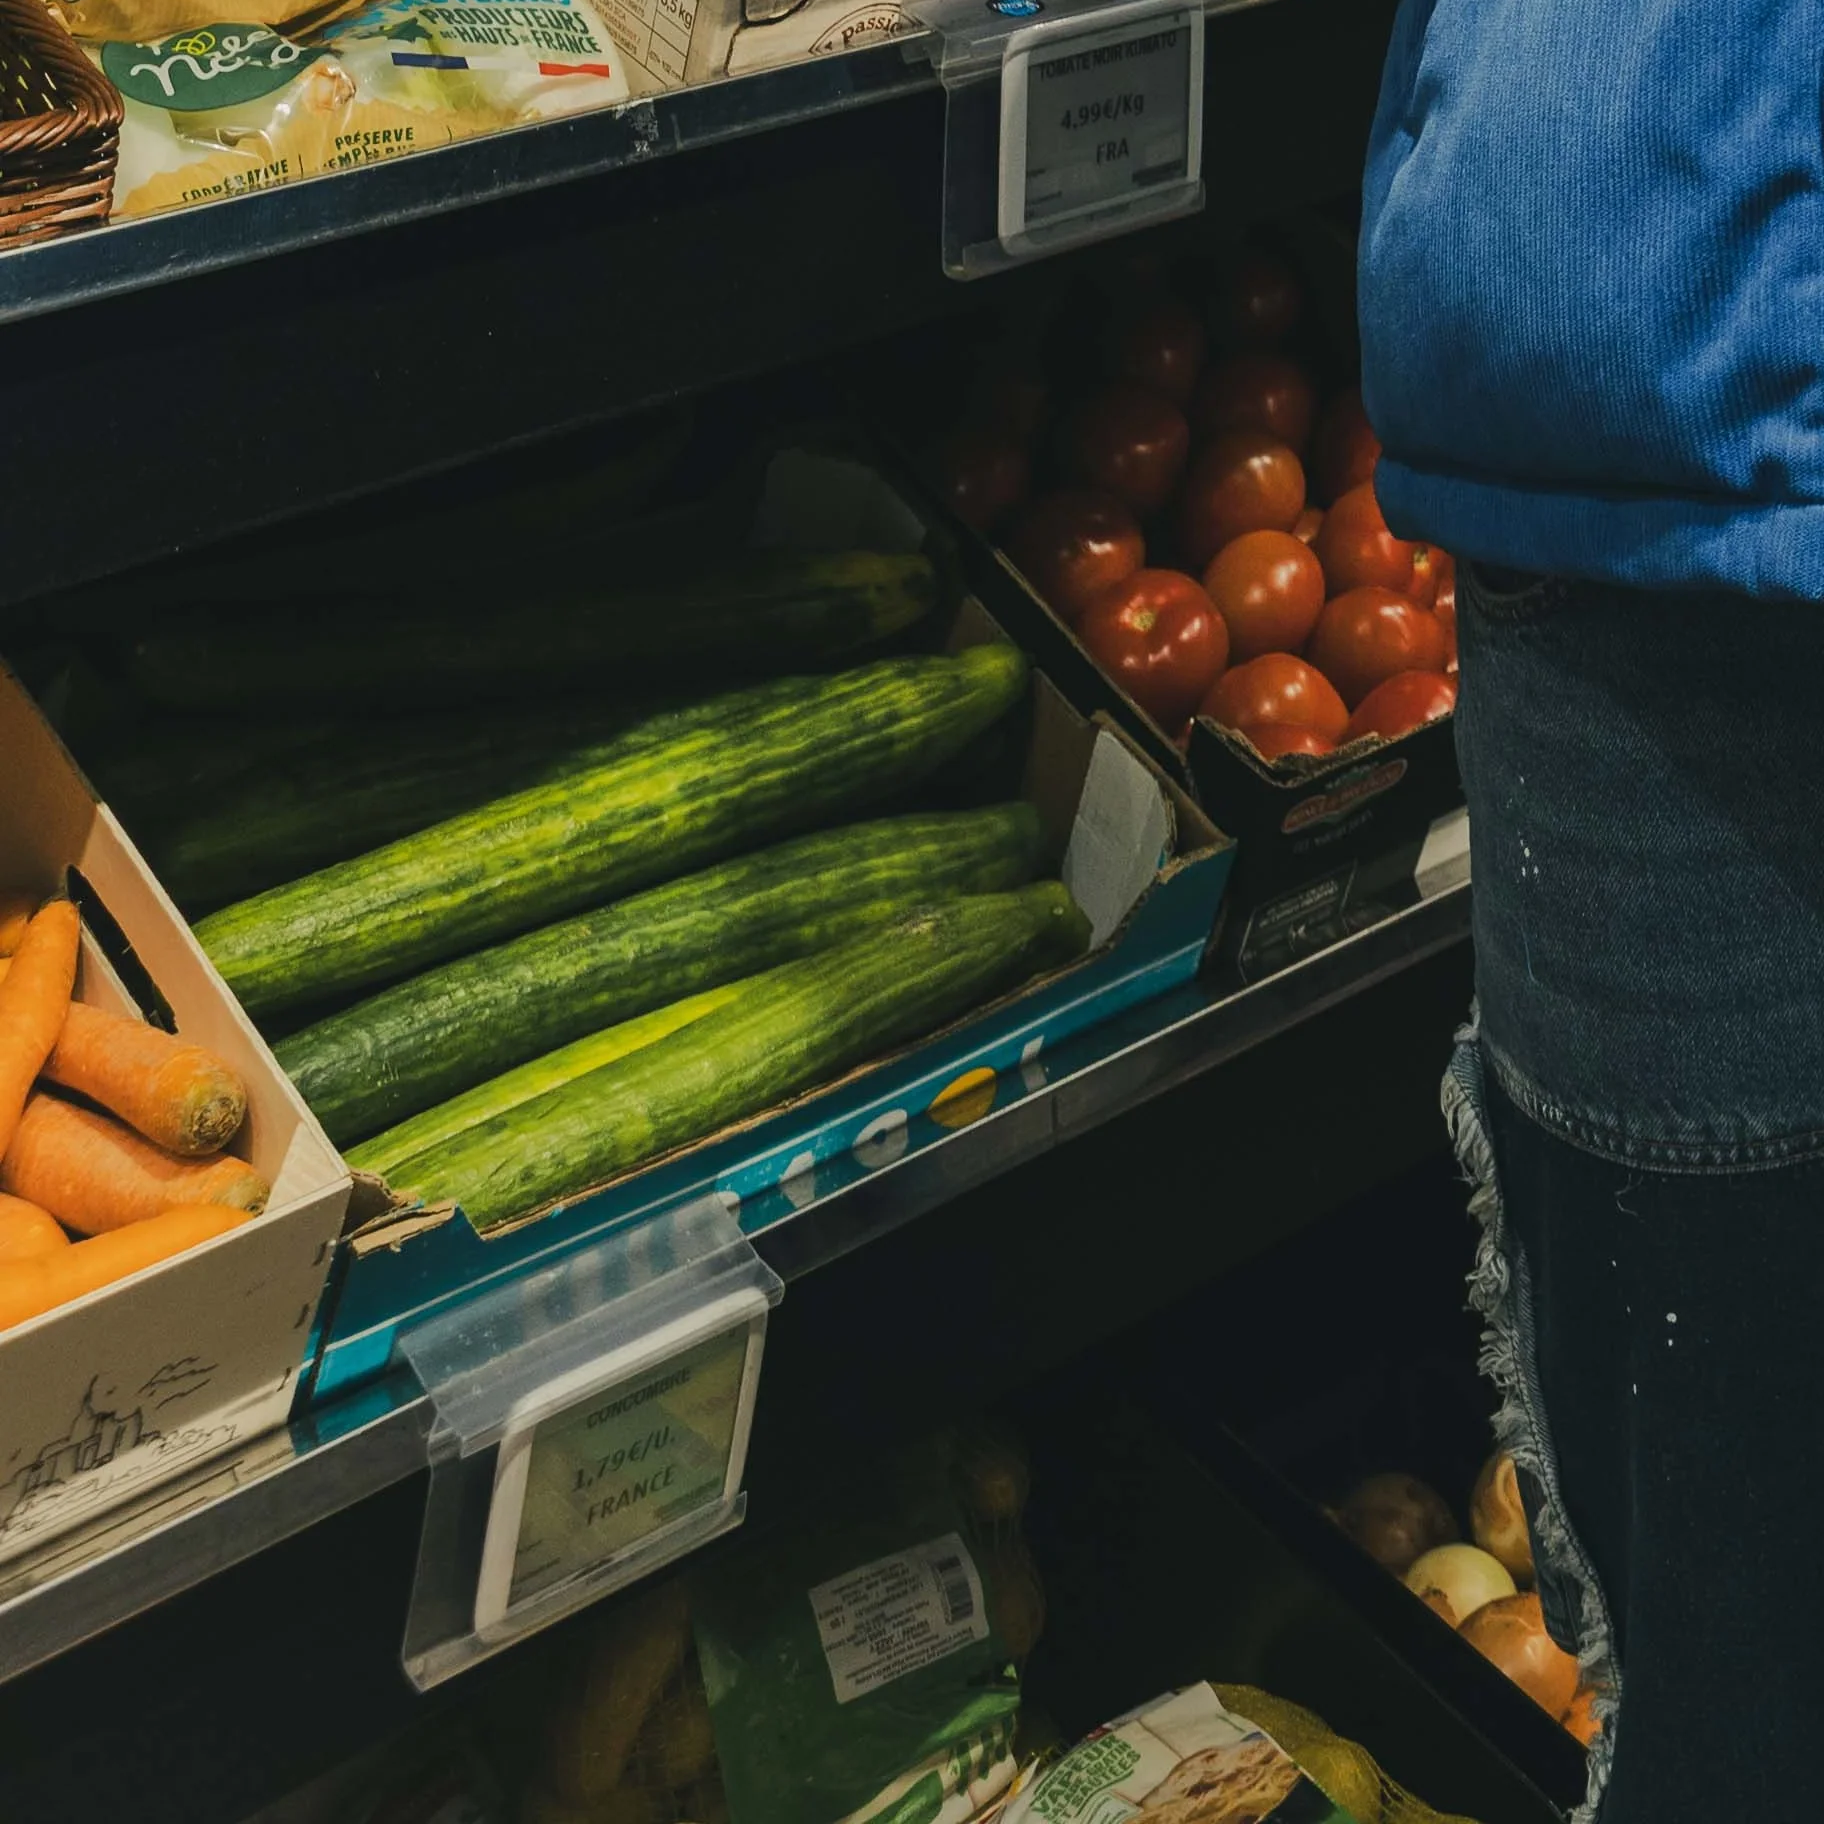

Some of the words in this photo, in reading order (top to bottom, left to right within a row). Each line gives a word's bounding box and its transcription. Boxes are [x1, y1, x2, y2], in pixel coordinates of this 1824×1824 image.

[418, 7, 590, 35] PRODUCTEURS
[678, 3, 693, 30] kg
[458, 26, 520, 47] HAUTS
[531, 31, 603, 54] FRANCE
[1039, 52, 1090, 81] TOMATE
[335, 127, 414, 151] PRÉSERVE
[1095, 141, 1130, 166] FRA
[586, 1367, 692, 1429] CONCOMBRE
[586, 1462, 677, 1527] FRANCE
[1030, 1733, 1121, 1814] VAPEUR
